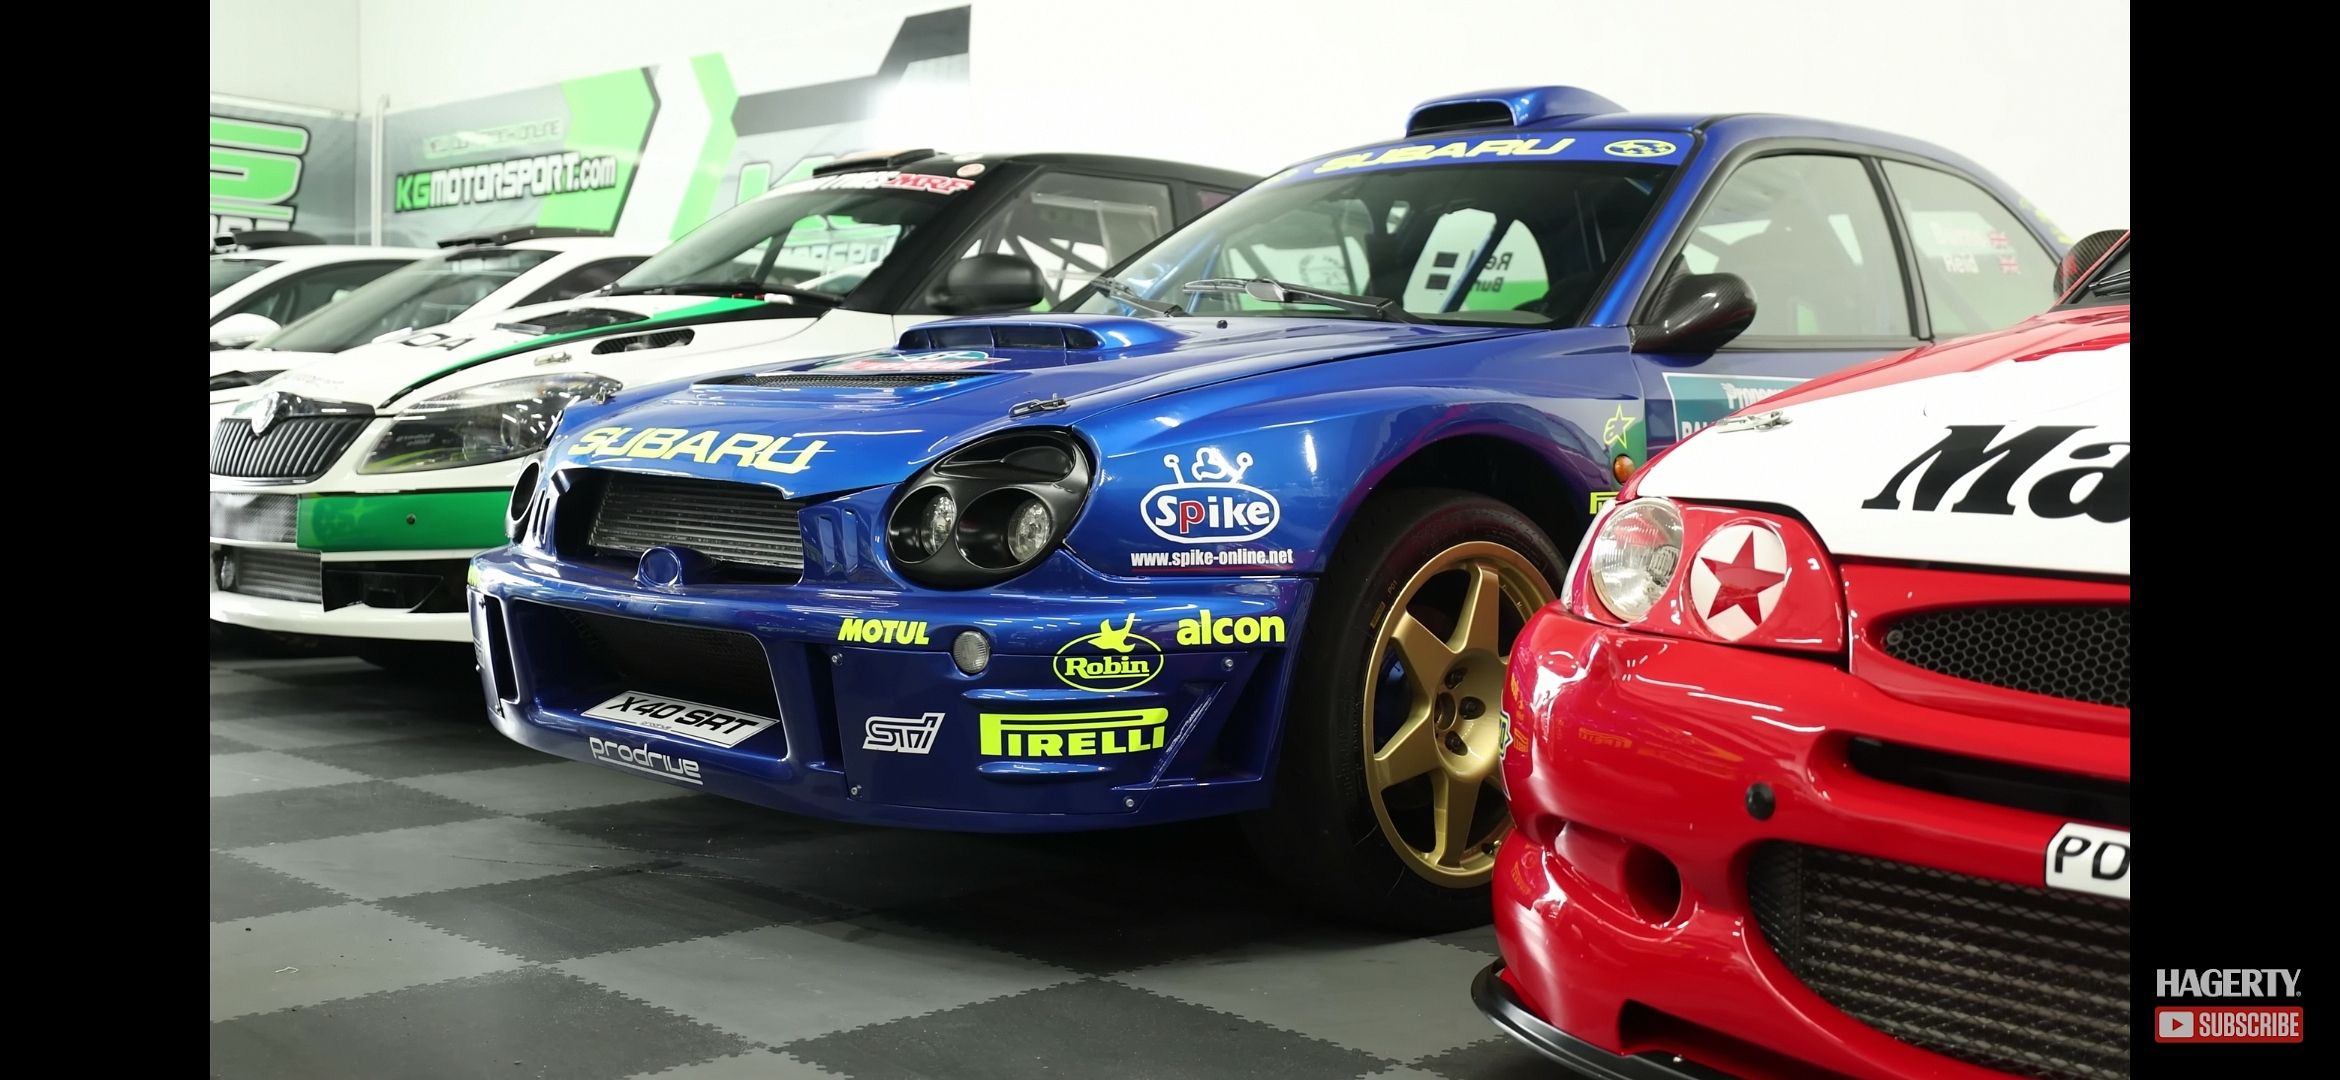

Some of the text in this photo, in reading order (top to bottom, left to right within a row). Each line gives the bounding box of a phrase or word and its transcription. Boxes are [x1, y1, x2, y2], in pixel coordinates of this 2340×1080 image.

[1313, 138, 1576, 174] SUBARU
[394, 150, 617, 212] KGMOTORSPORT.com
[567, 427, 828, 474] SUBARU
[1155, 493, 1271, 534] Spike
[1130, 547, 1294, 567] www.spike-online.net
[837, 617, 930, 646] MOTUL
[1176, 609, 1286, 646] alcon
[1064, 656, 1151, 678] Robin
[607, 696, 679, 720] X40
[675, 709, 760, 735] SRT
[979, 707, 1169, 757] PIRELLI
[589, 736, 702, 780] prodrive
